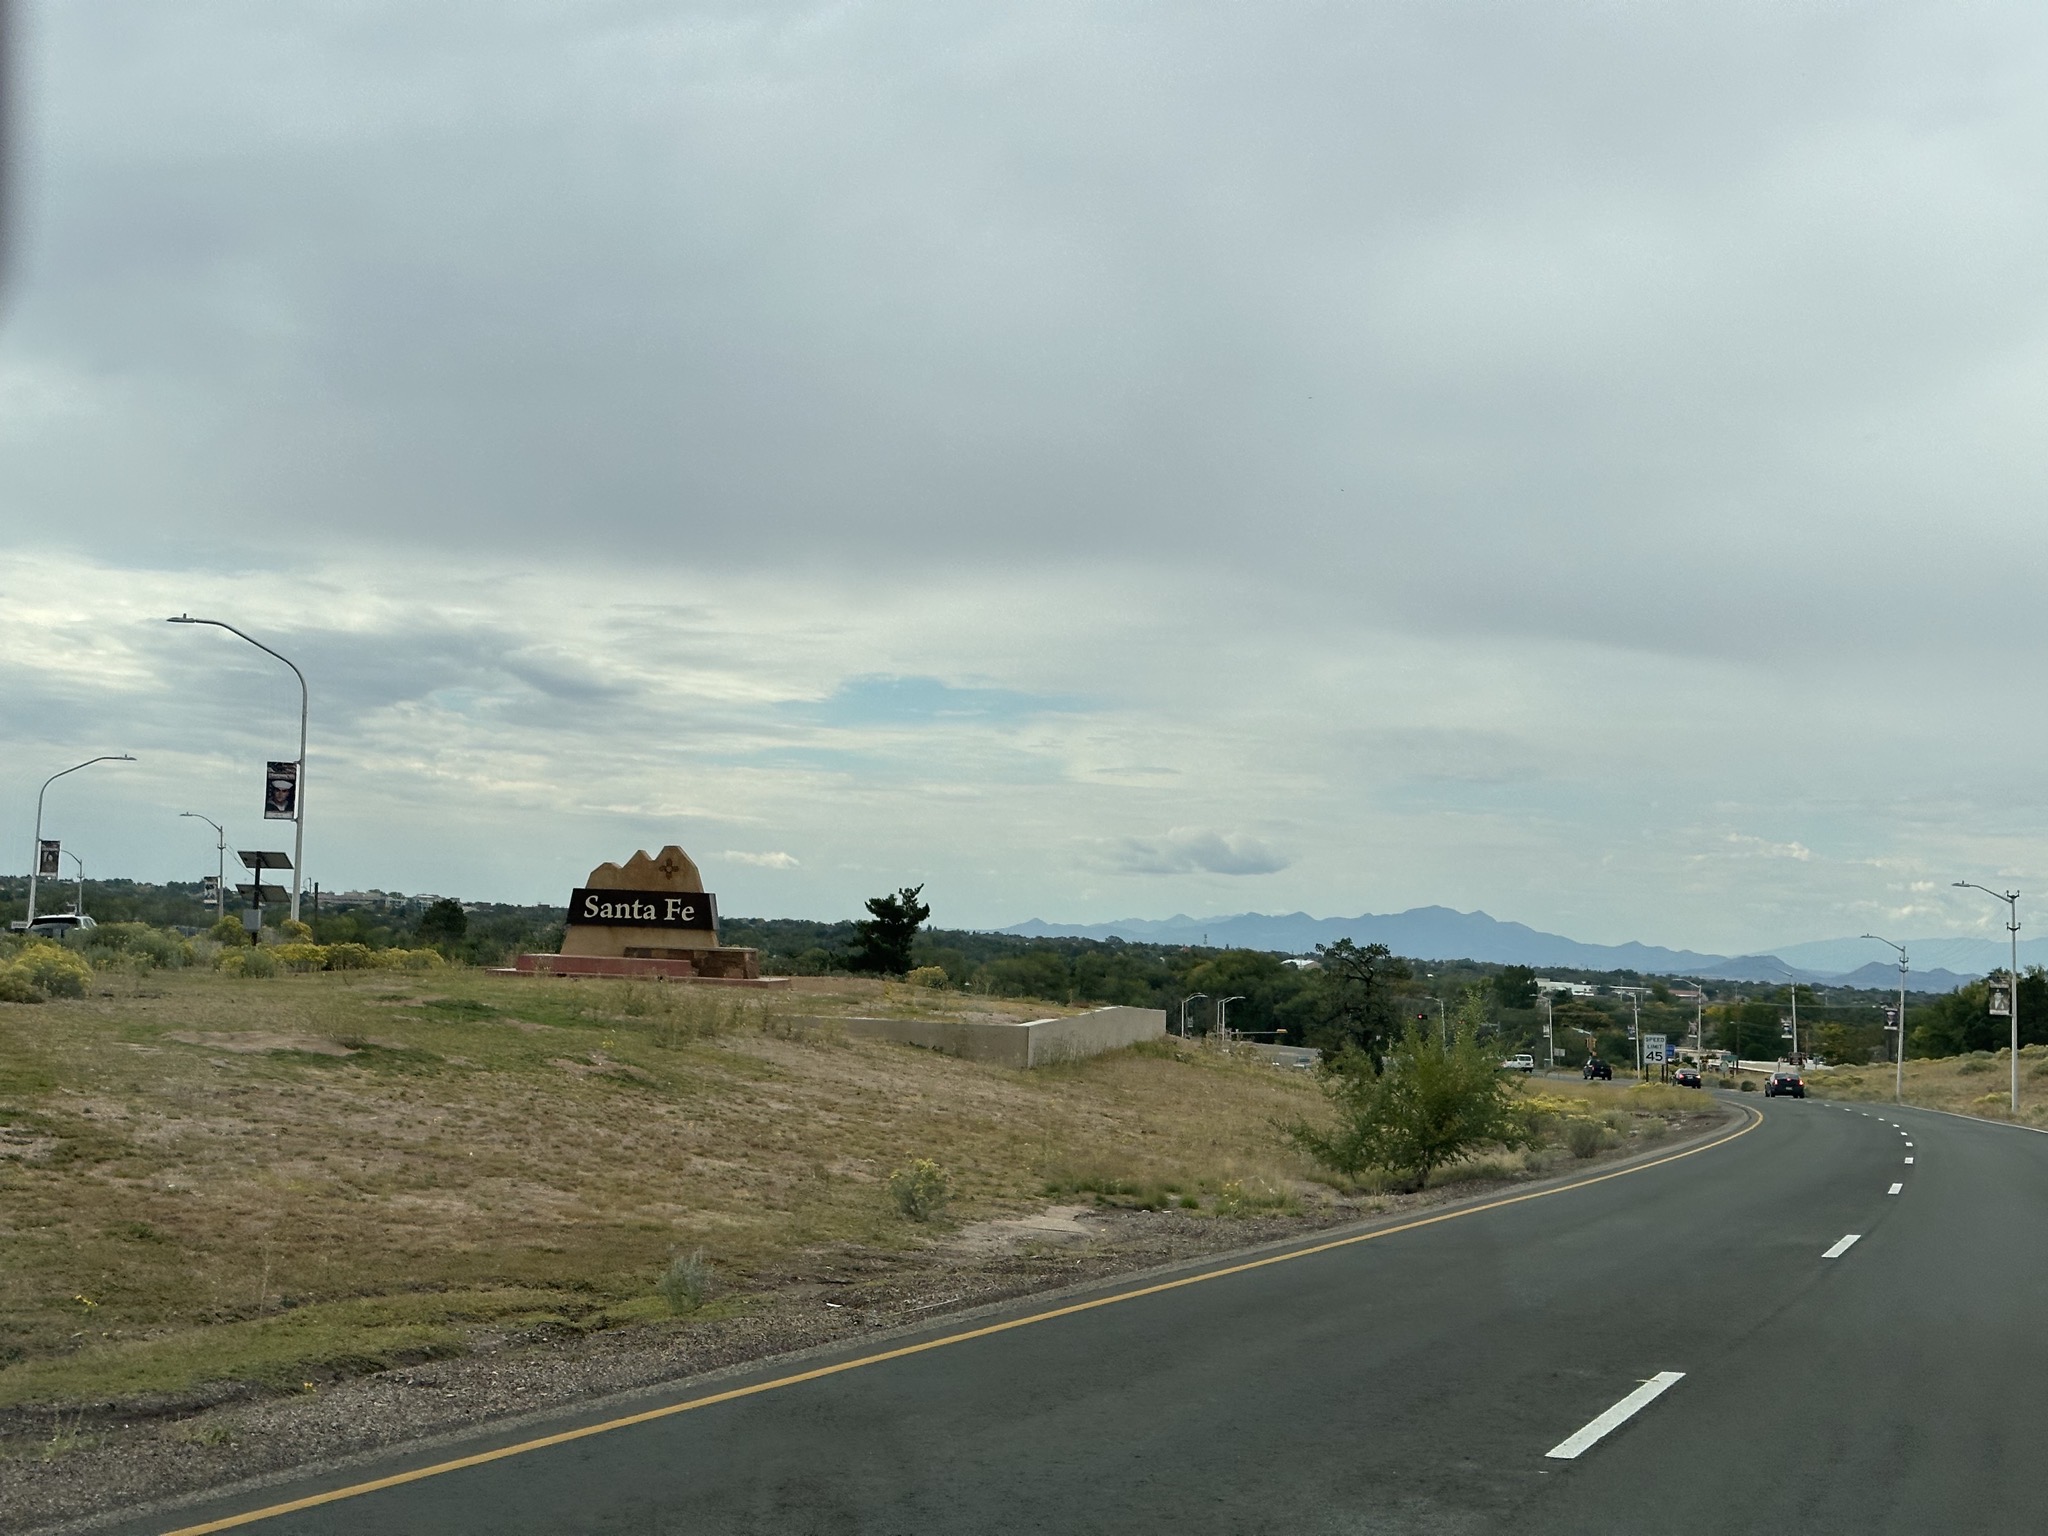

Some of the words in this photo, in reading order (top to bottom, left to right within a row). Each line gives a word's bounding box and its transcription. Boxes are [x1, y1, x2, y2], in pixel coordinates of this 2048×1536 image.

[583, 895, 657, 920] Santa
[663, 898, 695, 921] Fe
[1646, 1051, 1663, 1061] 45
